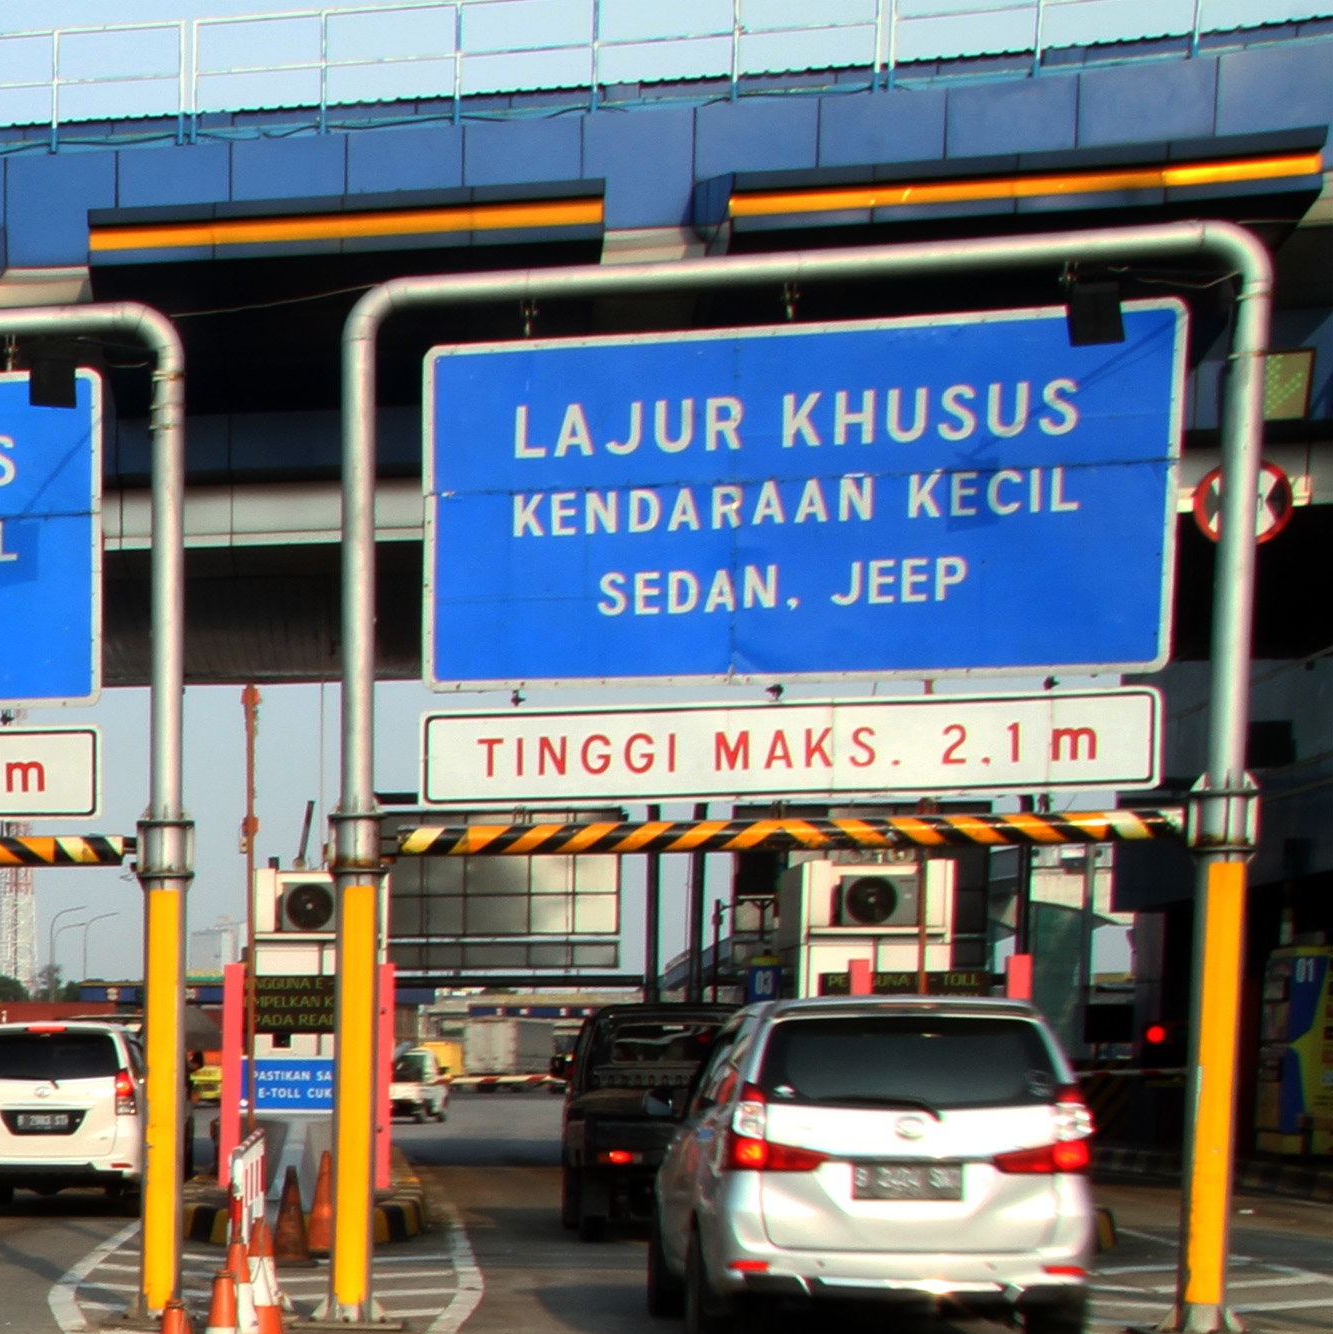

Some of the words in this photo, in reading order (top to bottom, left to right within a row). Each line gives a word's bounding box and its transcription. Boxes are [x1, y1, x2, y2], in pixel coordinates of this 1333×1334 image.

[516, 396, 743, 458] LAJUR
[784, 378, 1079, 447] KHUSUS
[514, 473, 873, 537] KENDARAAN
[909, 467, 1079, 517] KECIL
[598, 564, 799, 615] SEDAN,
[832, 556, 967, 605] JEEP
[476, 733, 676, 778] TINGGI
[714, 726, 900, 772] MAKS.
[258, 1088, 301, 1099] E-TOLL
